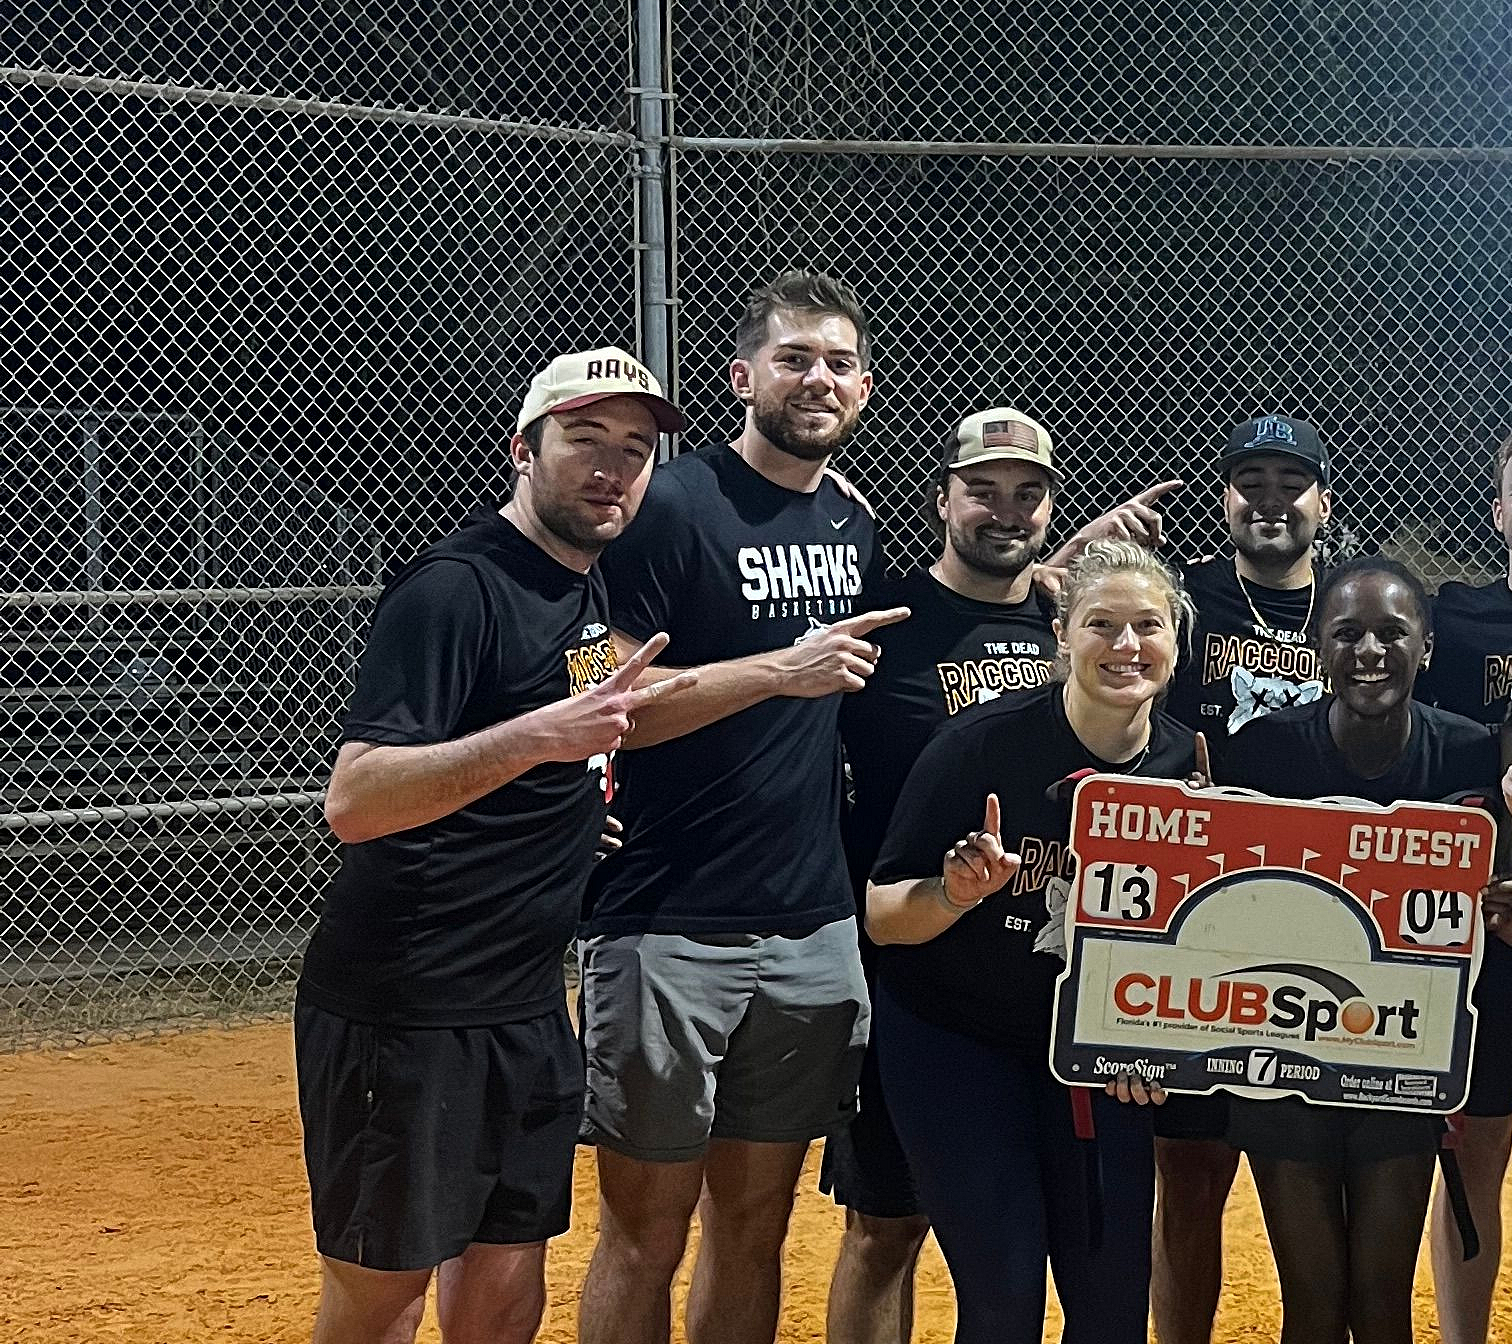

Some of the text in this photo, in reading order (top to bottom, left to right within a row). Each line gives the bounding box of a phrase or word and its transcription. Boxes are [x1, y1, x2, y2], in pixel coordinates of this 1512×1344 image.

[587, 359, 649, 391] RAYS
[738, 544, 861, 600] SHARKS
[984, 643, 1040, 656] THE DEAD
[1252, 625, 1307, 644] THE DEAD
[1203, 633, 1333, 694] RACCOO
[1088, 801, 1211, 847] HOME
[1349, 824, 1480, 869] GUEST
[1094, 864, 1151, 921] 13
[1406, 889, 1464, 934] 04
[1200, 1024, 1209, 1032] of
[1237, 1027, 1264, 1037] Sports
[1207, 1052, 1321, 1081] INNING 7 PERIOD
